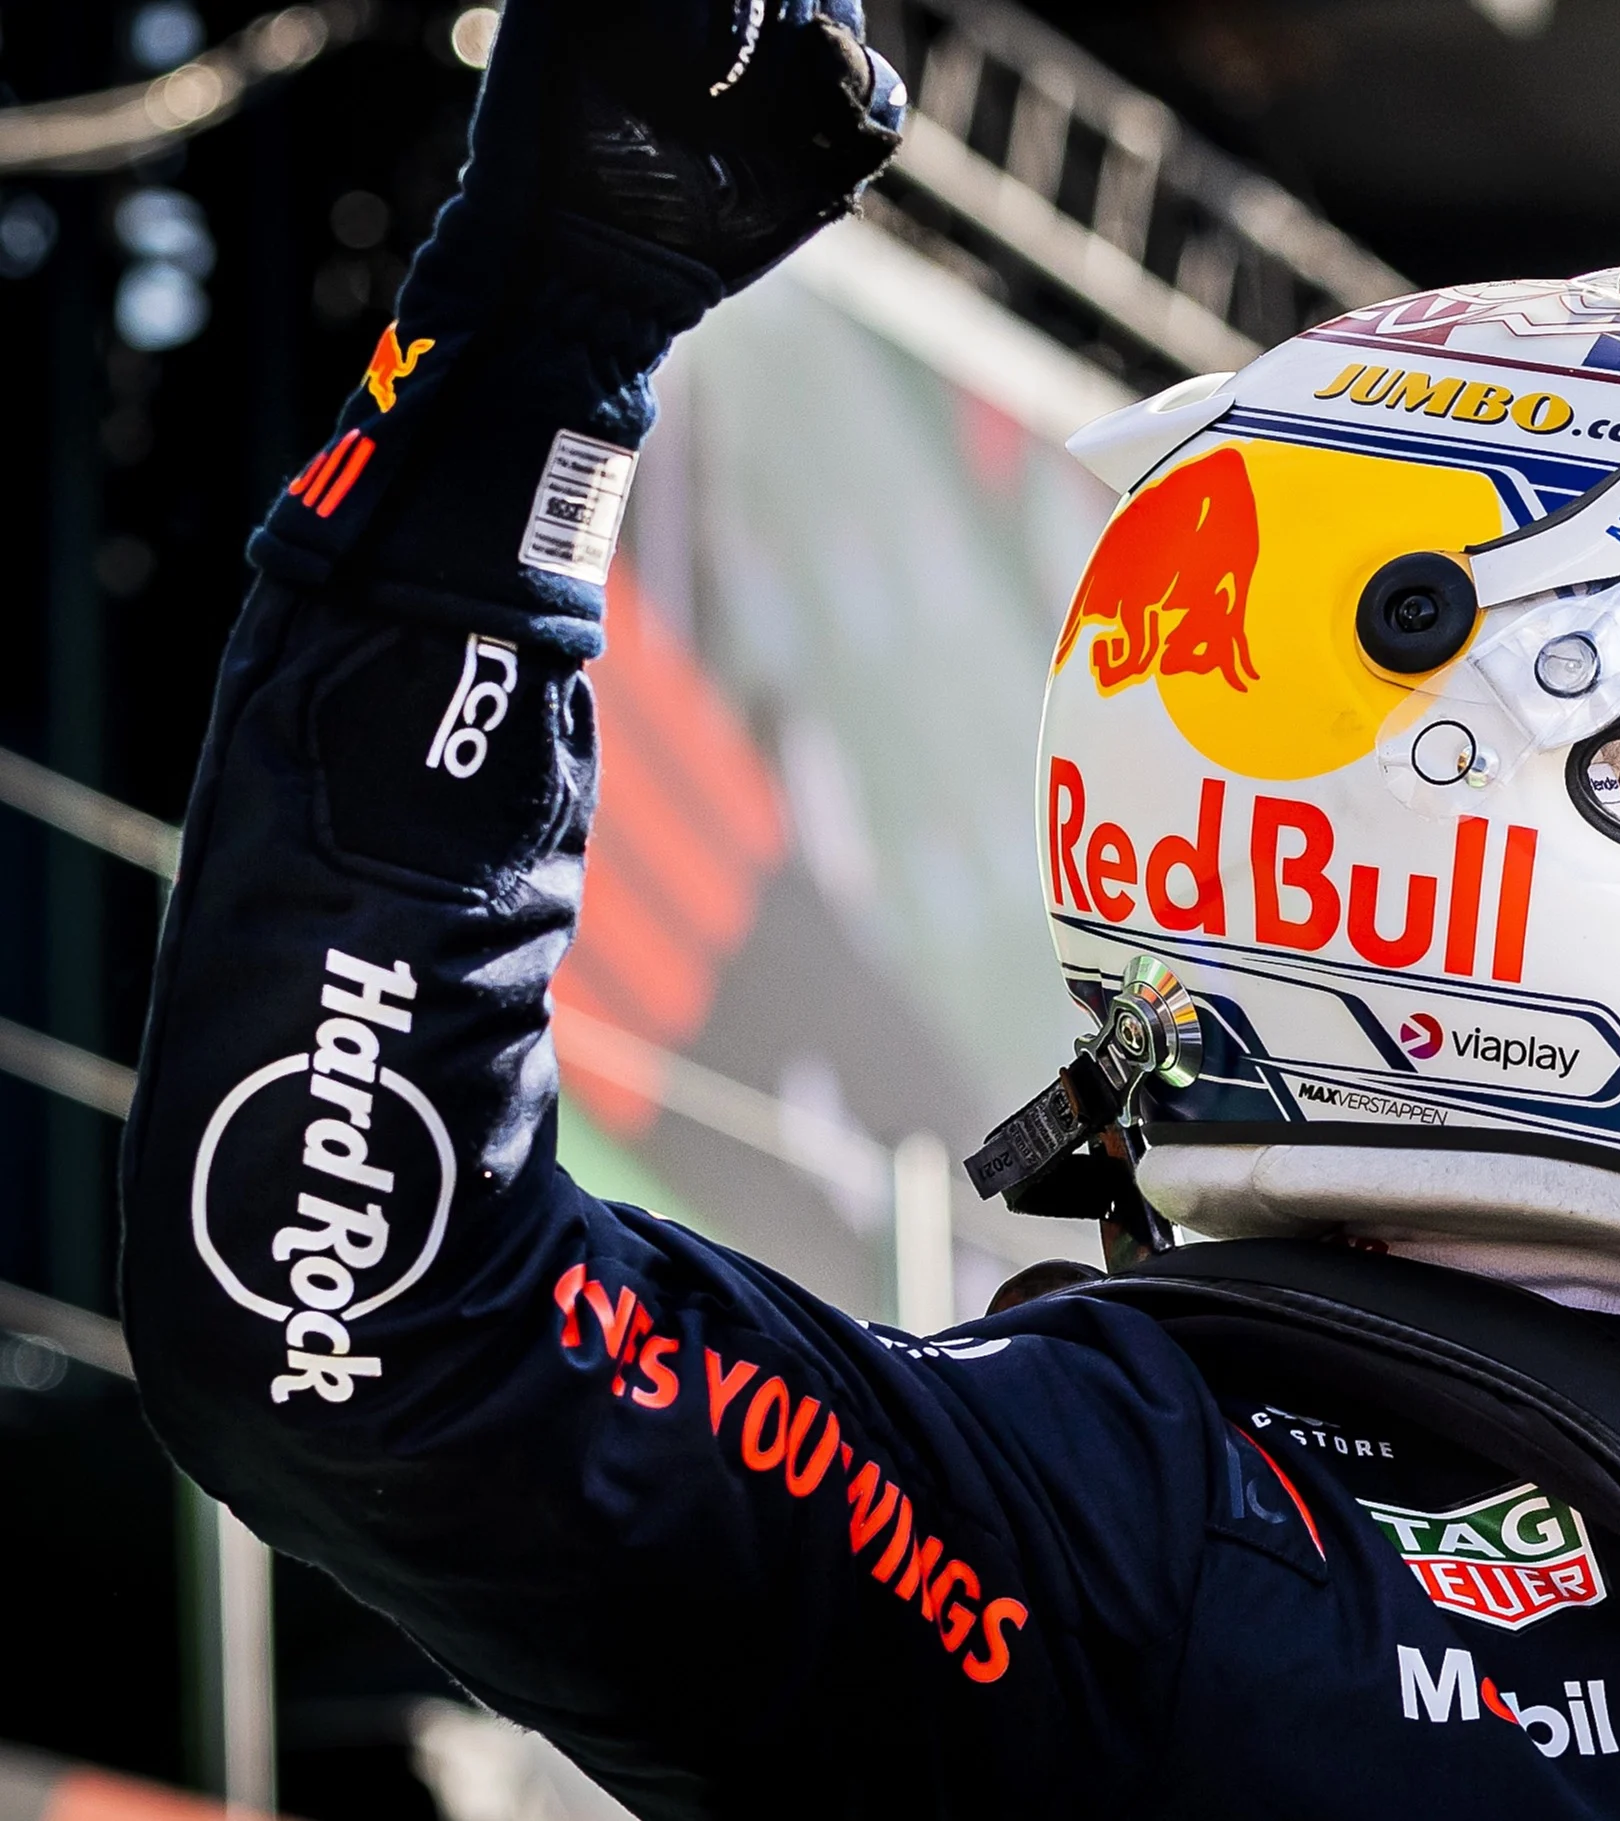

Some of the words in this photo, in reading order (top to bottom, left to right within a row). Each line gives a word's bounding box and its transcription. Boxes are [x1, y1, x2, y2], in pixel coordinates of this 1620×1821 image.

[1049, 756, 1227, 937] Red
[1250, 795, 1539, 984] Bull
[302, 947, 418, 1194] Hard
[1452, 1027, 1580, 1078] viaplay
[978, 1150, 1015, 1183] 2021
[270, 1192, 390, 1404] Rock
[704, 1346, 840, 1498] YOU
[1370, 1496, 1567, 1560] TAG
